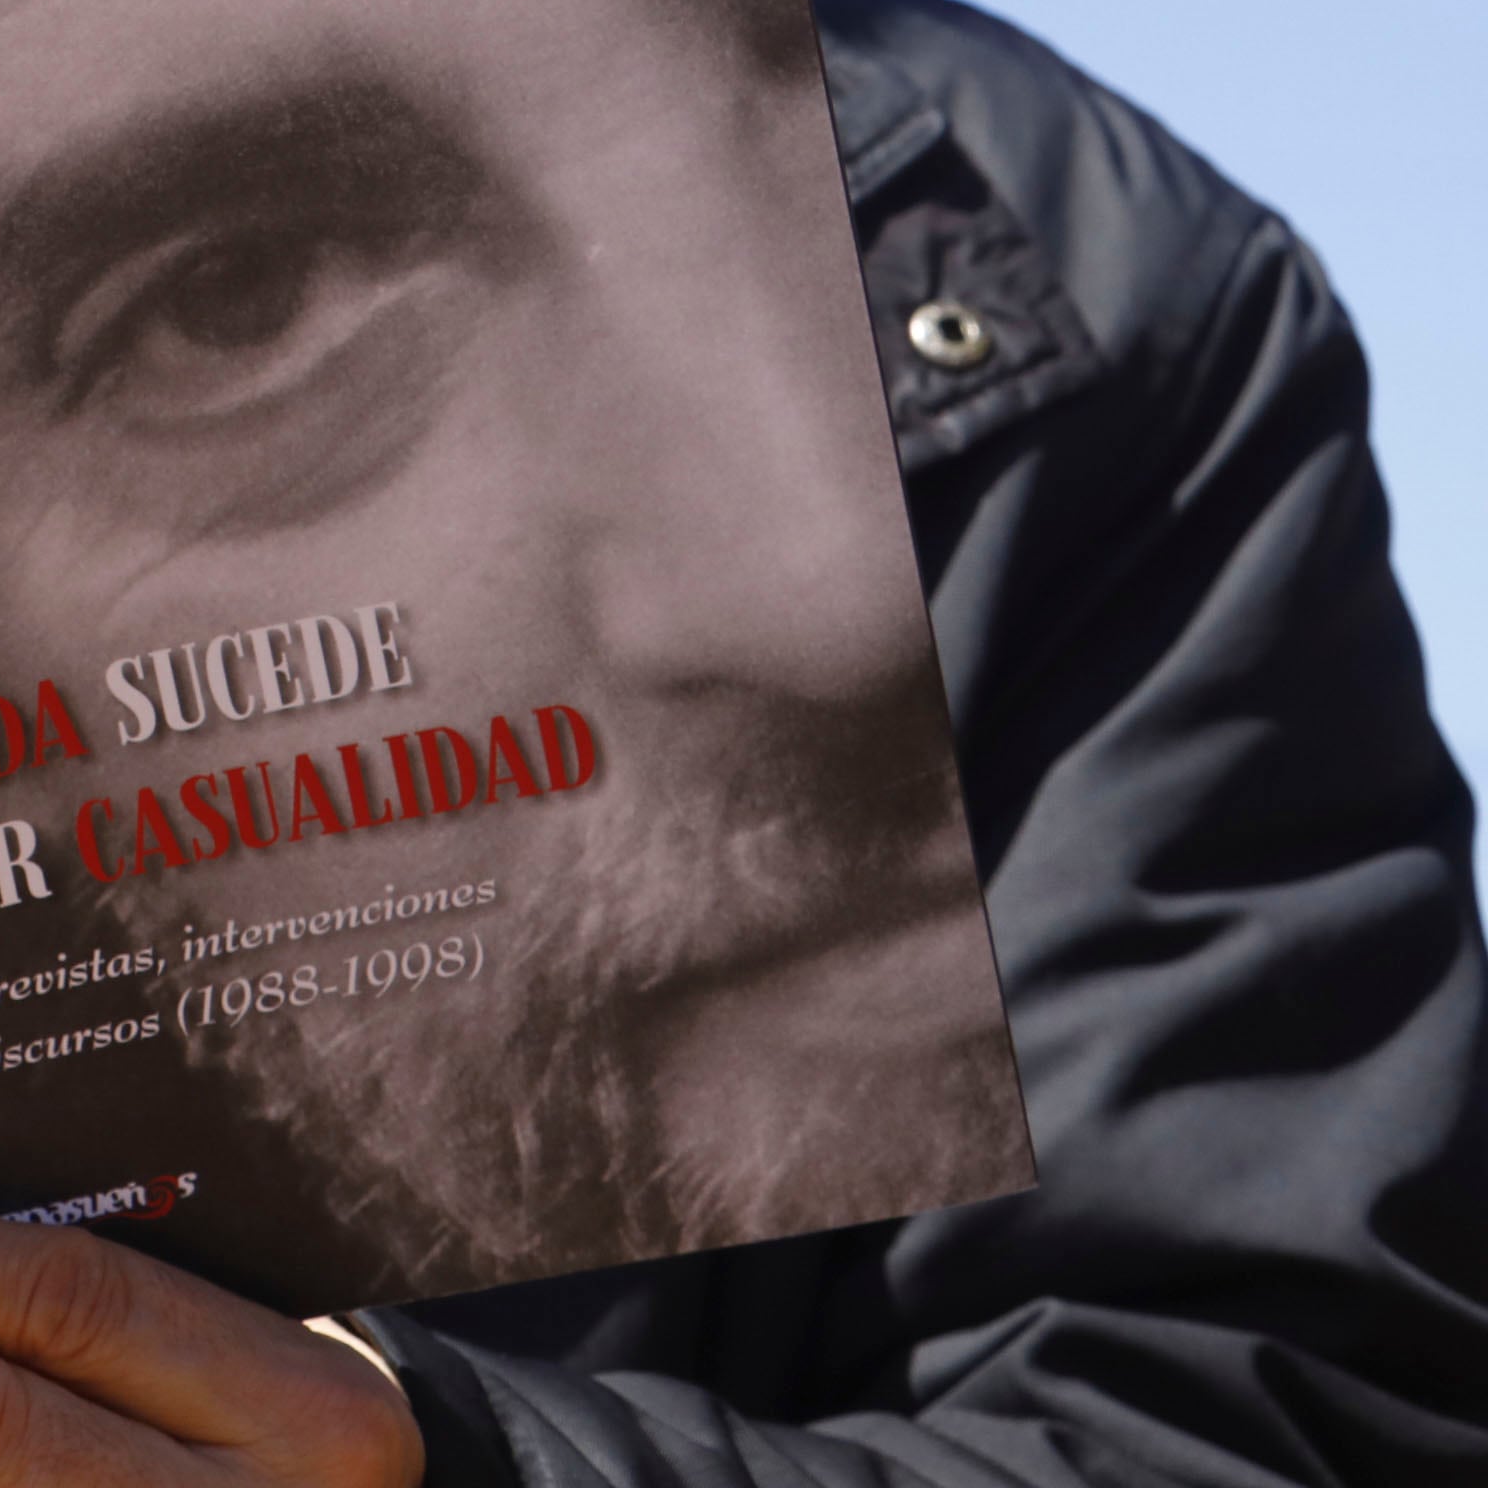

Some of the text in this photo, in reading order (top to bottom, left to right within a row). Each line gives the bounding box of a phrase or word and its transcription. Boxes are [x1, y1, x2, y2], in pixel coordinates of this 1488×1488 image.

[105, 601, 412, 746] SUCEDE
[76, 703, 597, 885] CASUALIDAD
[182, 879, 498, 965] intervenciones
[176, 933, 485, 1035] (1988-1998)
